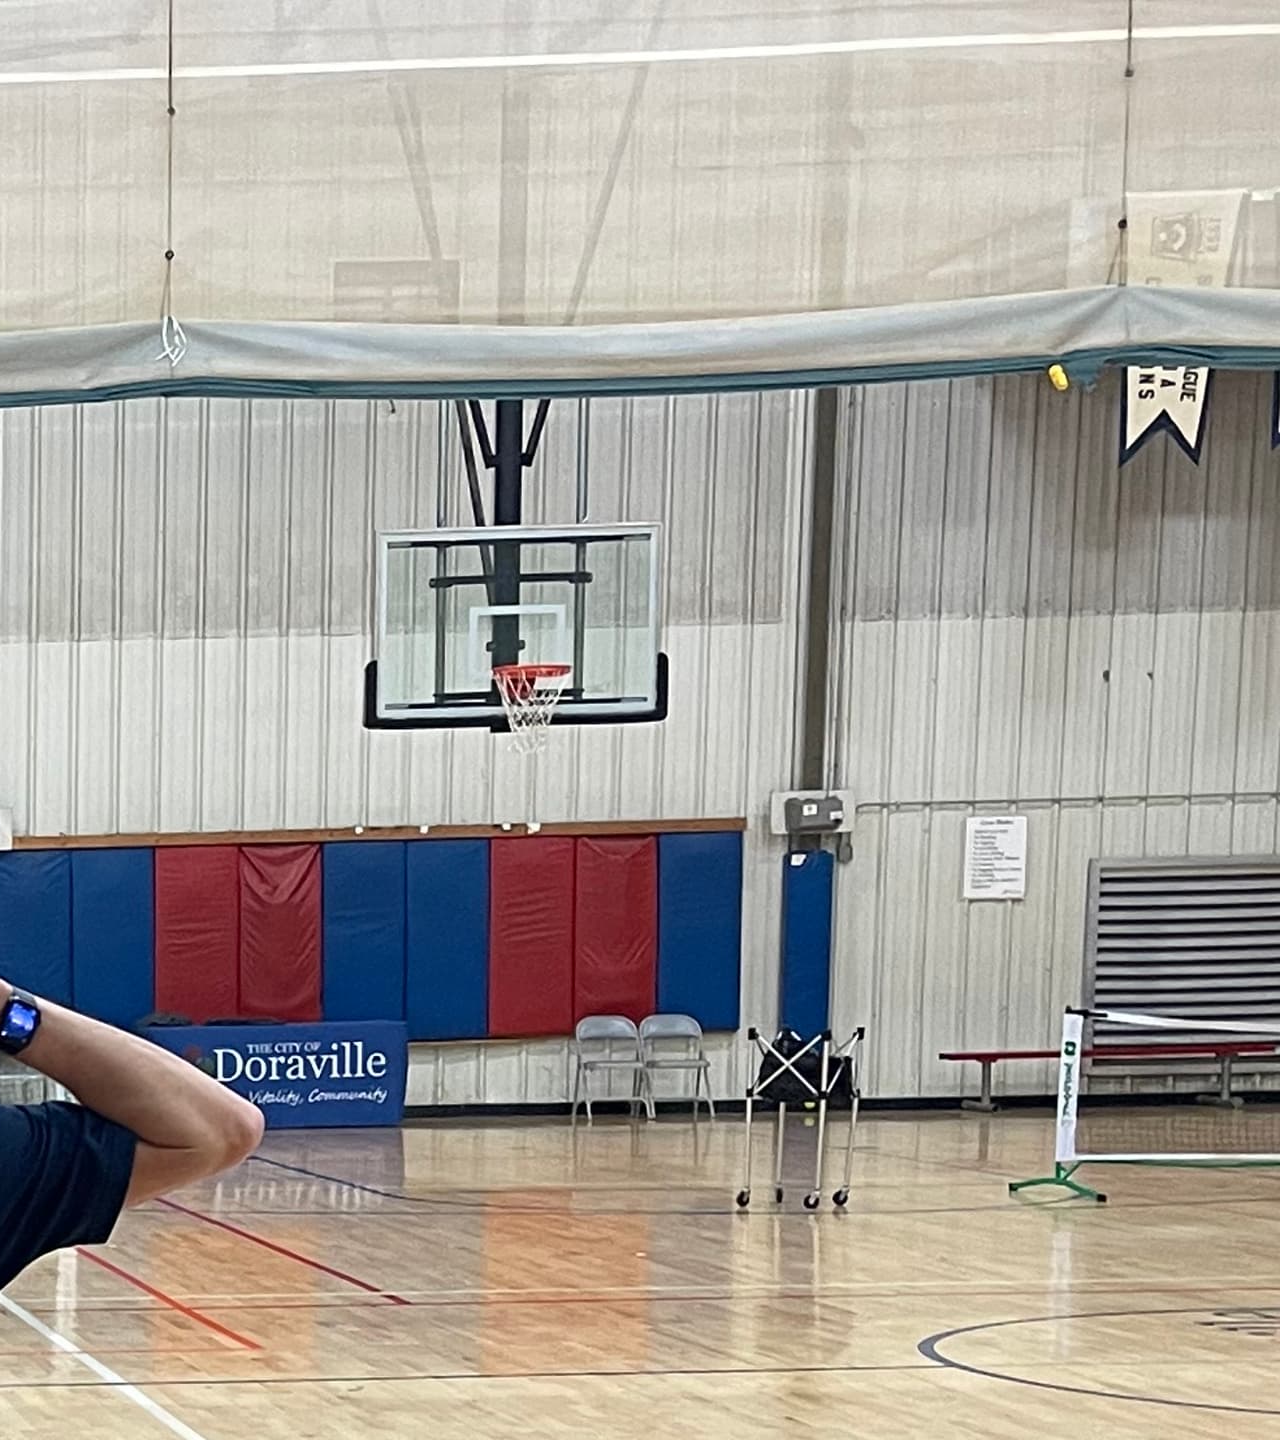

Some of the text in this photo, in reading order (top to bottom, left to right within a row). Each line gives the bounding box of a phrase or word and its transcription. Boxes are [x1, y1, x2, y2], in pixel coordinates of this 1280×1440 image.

[1138, 365, 1156, 400] NS
[1180, 365, 1199, 402] GUE
[213, 1041, 387, 1082] Doraville
[246, 1041, 322, 1054] THE CITY OF
[308, 1085, 388, 1104] Community
